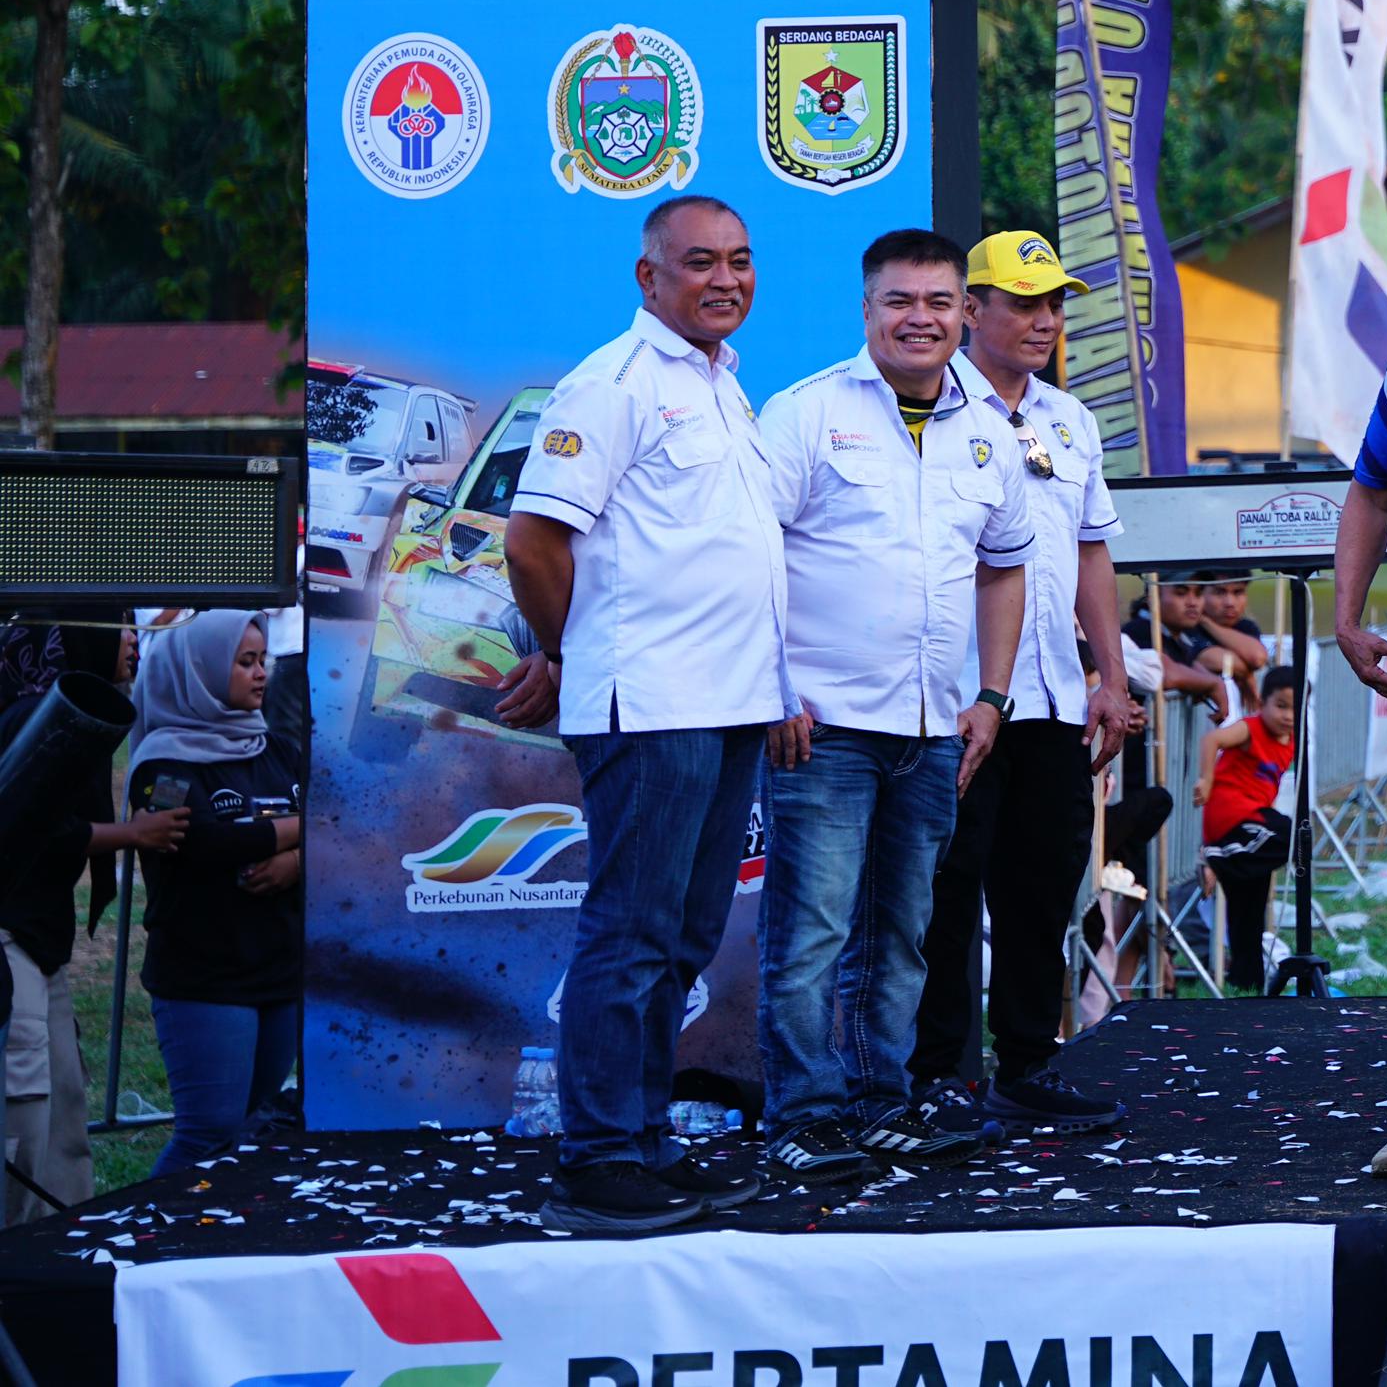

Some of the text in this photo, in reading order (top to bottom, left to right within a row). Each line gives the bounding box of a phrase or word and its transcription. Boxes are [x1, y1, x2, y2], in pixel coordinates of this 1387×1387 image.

[778, 29, 885, 44] SERDANG BEDAGAI
[355, 47, 478, 135] KEMENTERIAN PEMUDA DAN OLAHRAGA
[366, 149, 468, 185] REPUBLIK INDONESIA
[578, 162, 671, 190] SUMATERA UTARA
[1240, 510, 1332, 525] DANAU TOBA RALLY
[413, 885, 587, 908] Perkebunan Nusantara
